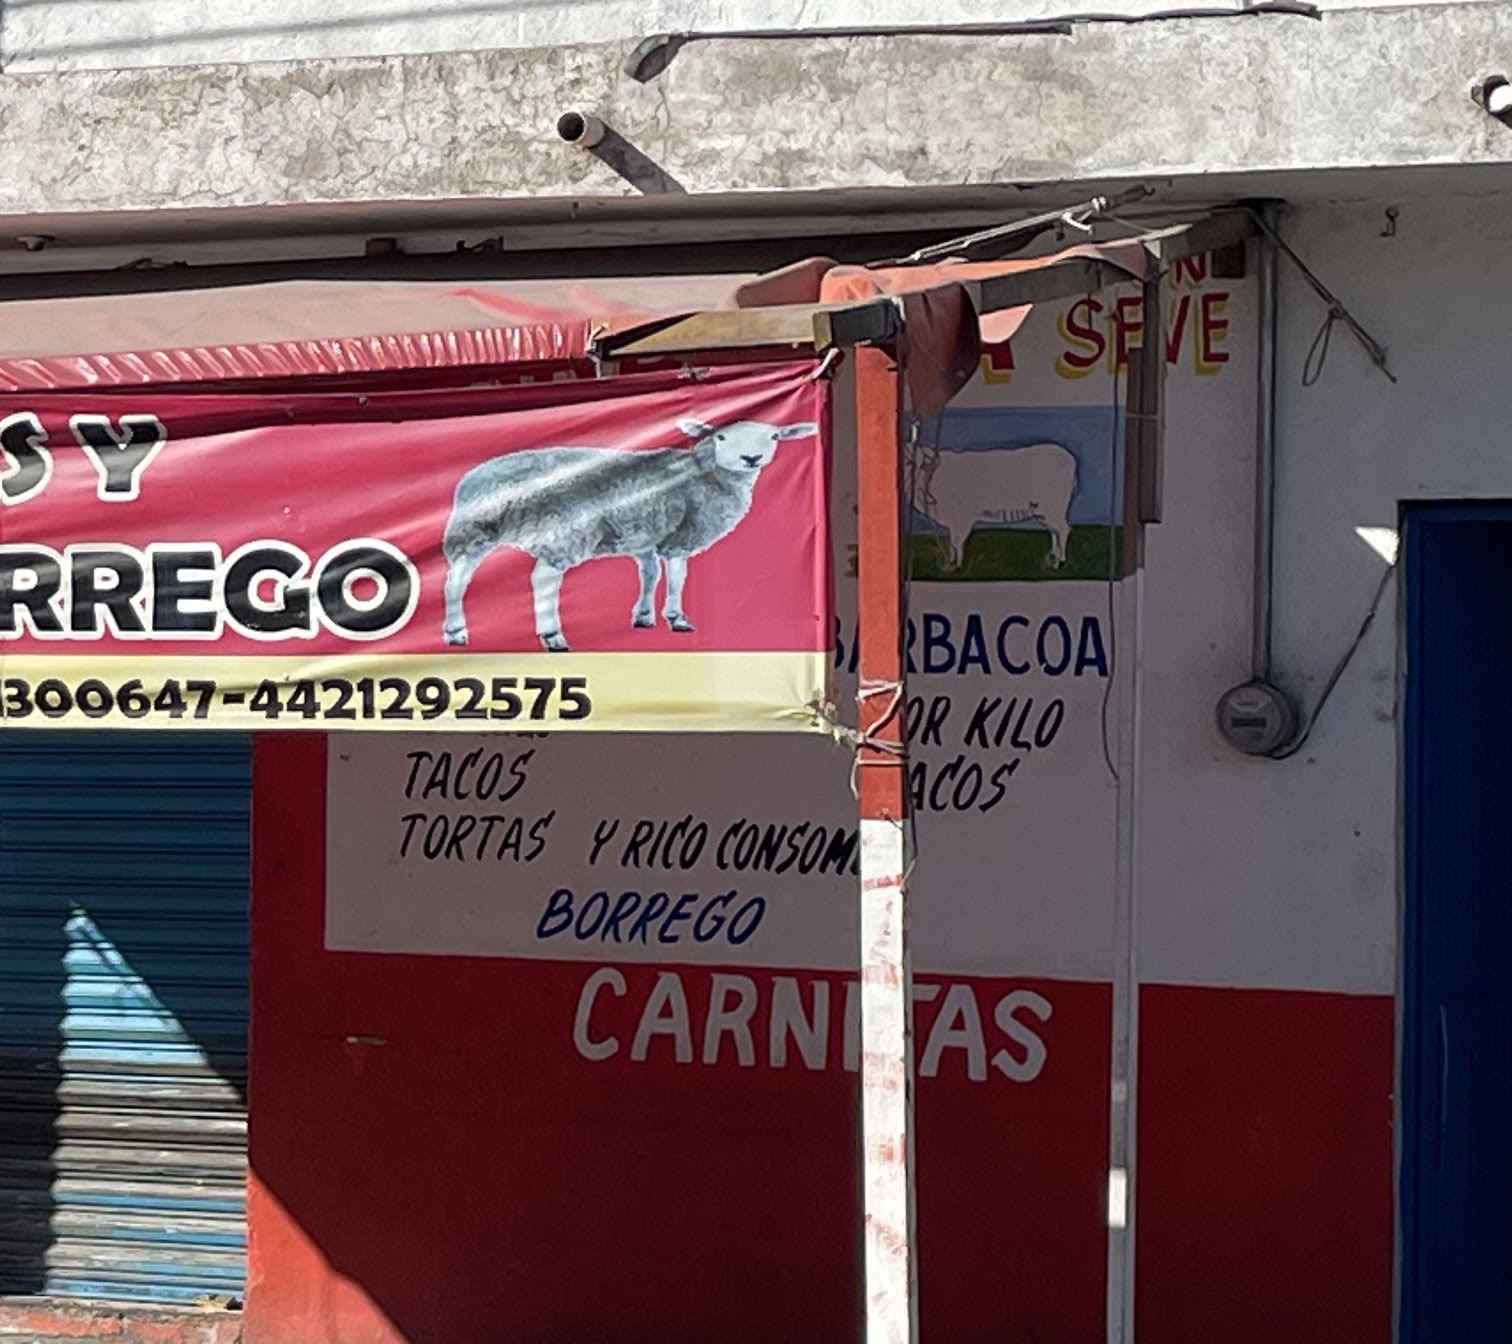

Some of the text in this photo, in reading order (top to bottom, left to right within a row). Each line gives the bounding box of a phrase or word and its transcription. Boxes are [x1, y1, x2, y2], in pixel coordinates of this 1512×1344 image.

[70, 414, 166, 501] Y
[835, 613, 1109, 676] BACOA
[905, 696, 1065, 752] OR KILO
[404, 747, 536, 802] TACOS
[909, 755, 1021, 812] ACOS
[400, 809, 556, 862] TORTAS
[589, 819, 620, 866] Y
[620, 814, 709, 870] RICO
[538, 889, 767, 946] BORREGO
